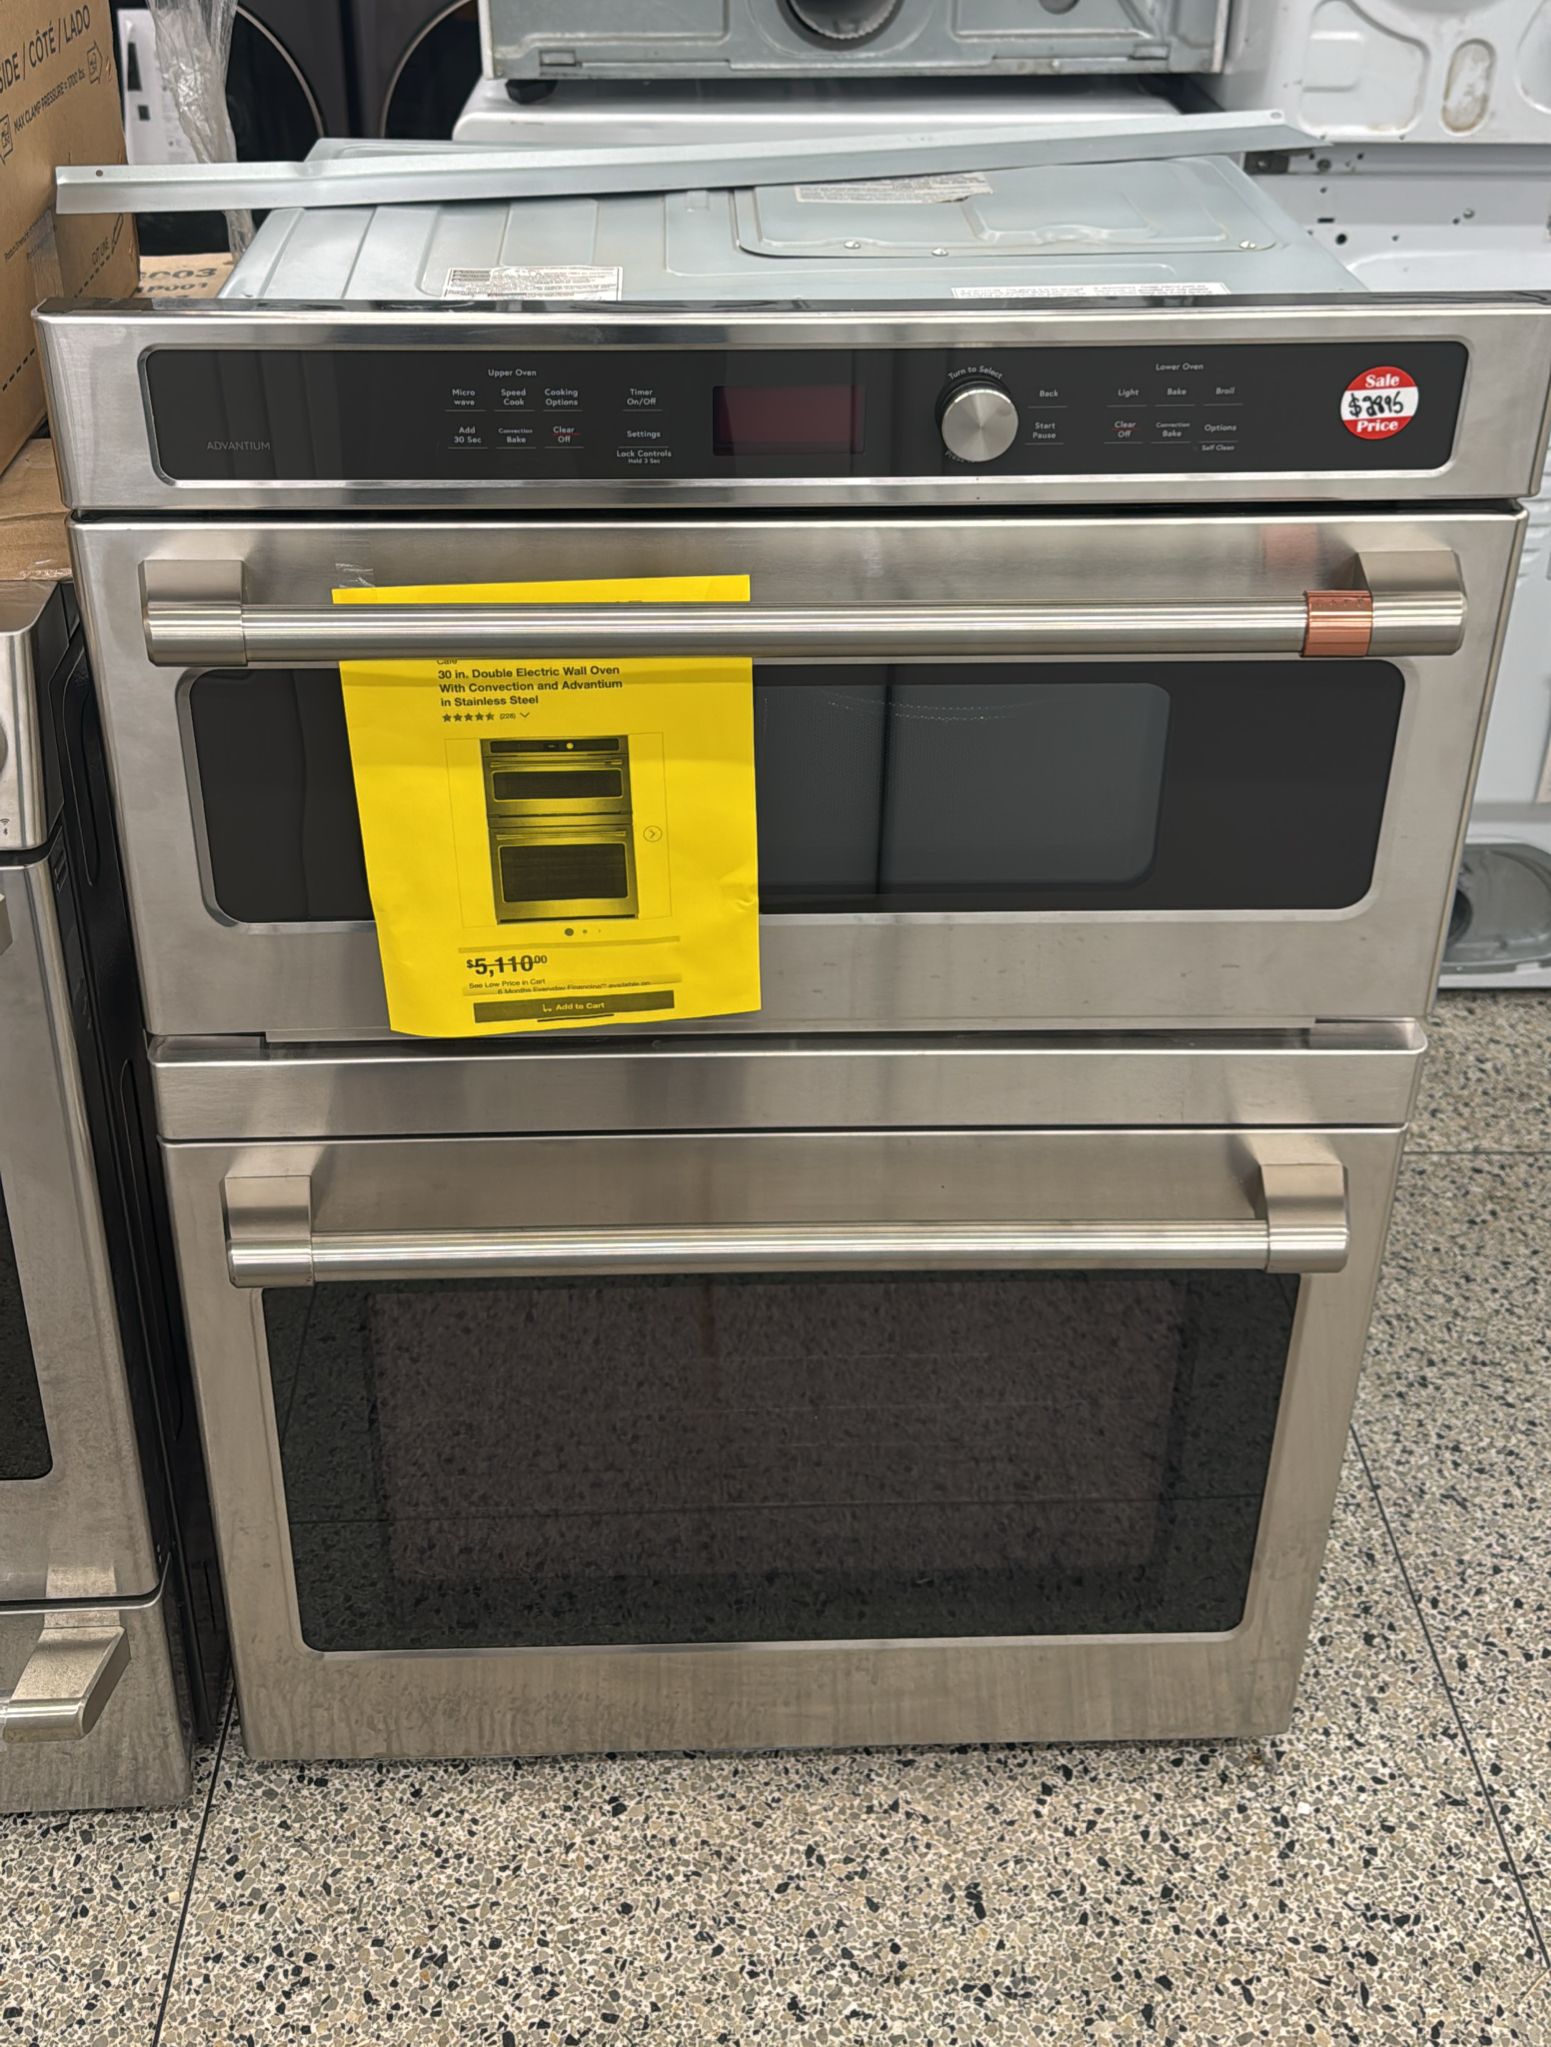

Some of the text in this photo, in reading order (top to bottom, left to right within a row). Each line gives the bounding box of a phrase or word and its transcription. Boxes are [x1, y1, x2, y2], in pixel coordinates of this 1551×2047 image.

[29, 20, 56, 68] CÔTÉ
[63, 5, 91, 43] LADO
[1155, 362, 1204, 371] Lower Oven
[488, 368, 537, 378] Upper Oven
[948, 367, 967, 380] Turn
[979, 365, 1003, 380] Select
[1364, 373, 1400, 389] Sale
[452, 388, 475, 397] Micro
[501, 387, 526, 398] Speed
[544, 388, 578, 398] Cooking
[629, 388, 653, 396] Timer
[1039, 389, 1059, 398] Back
[1118, 388, 1139, 398] Light
[1167, 388, 1187, 396] Bake
[1215, 387, 1235, 395] Broil
[503, 398, 525, 406] Cook
[545, 398, 578, 408] Options
[626, 397, 657, 407] On/Off
[1034, 422, 1056, 430] Start
[1114, 420, 1137, 429] Clear
[1204, 424, 1237, 433] Options
[1356, 419, 1399, 433] Price
[459, 426, 476, 435] Add
[553, 425, 575, 434] Clear
[1117, 430, 1132, 438] Off
[1162, 430, 1182, 438] Bake
[454, 435, 482, 444] 30 Sec
[506, 435, 527, 444] Bake
[558, 435, 571, 443] Off
[626, 430, 661, 440] Settings
[206, 441, 271, 450] ADVANTIUM
[616, 449, 672, 458] Lock Controls
[438, 665, 620, 680] 30 in. Double Electric Wall Oven
[439, 678, 623, 694] With Convection and Advantium
[441, 695, 539, 707] in Stainless Steel
[556, 1003, 574, 1011] Add
[586, 1002, 605, 1010] Cart
